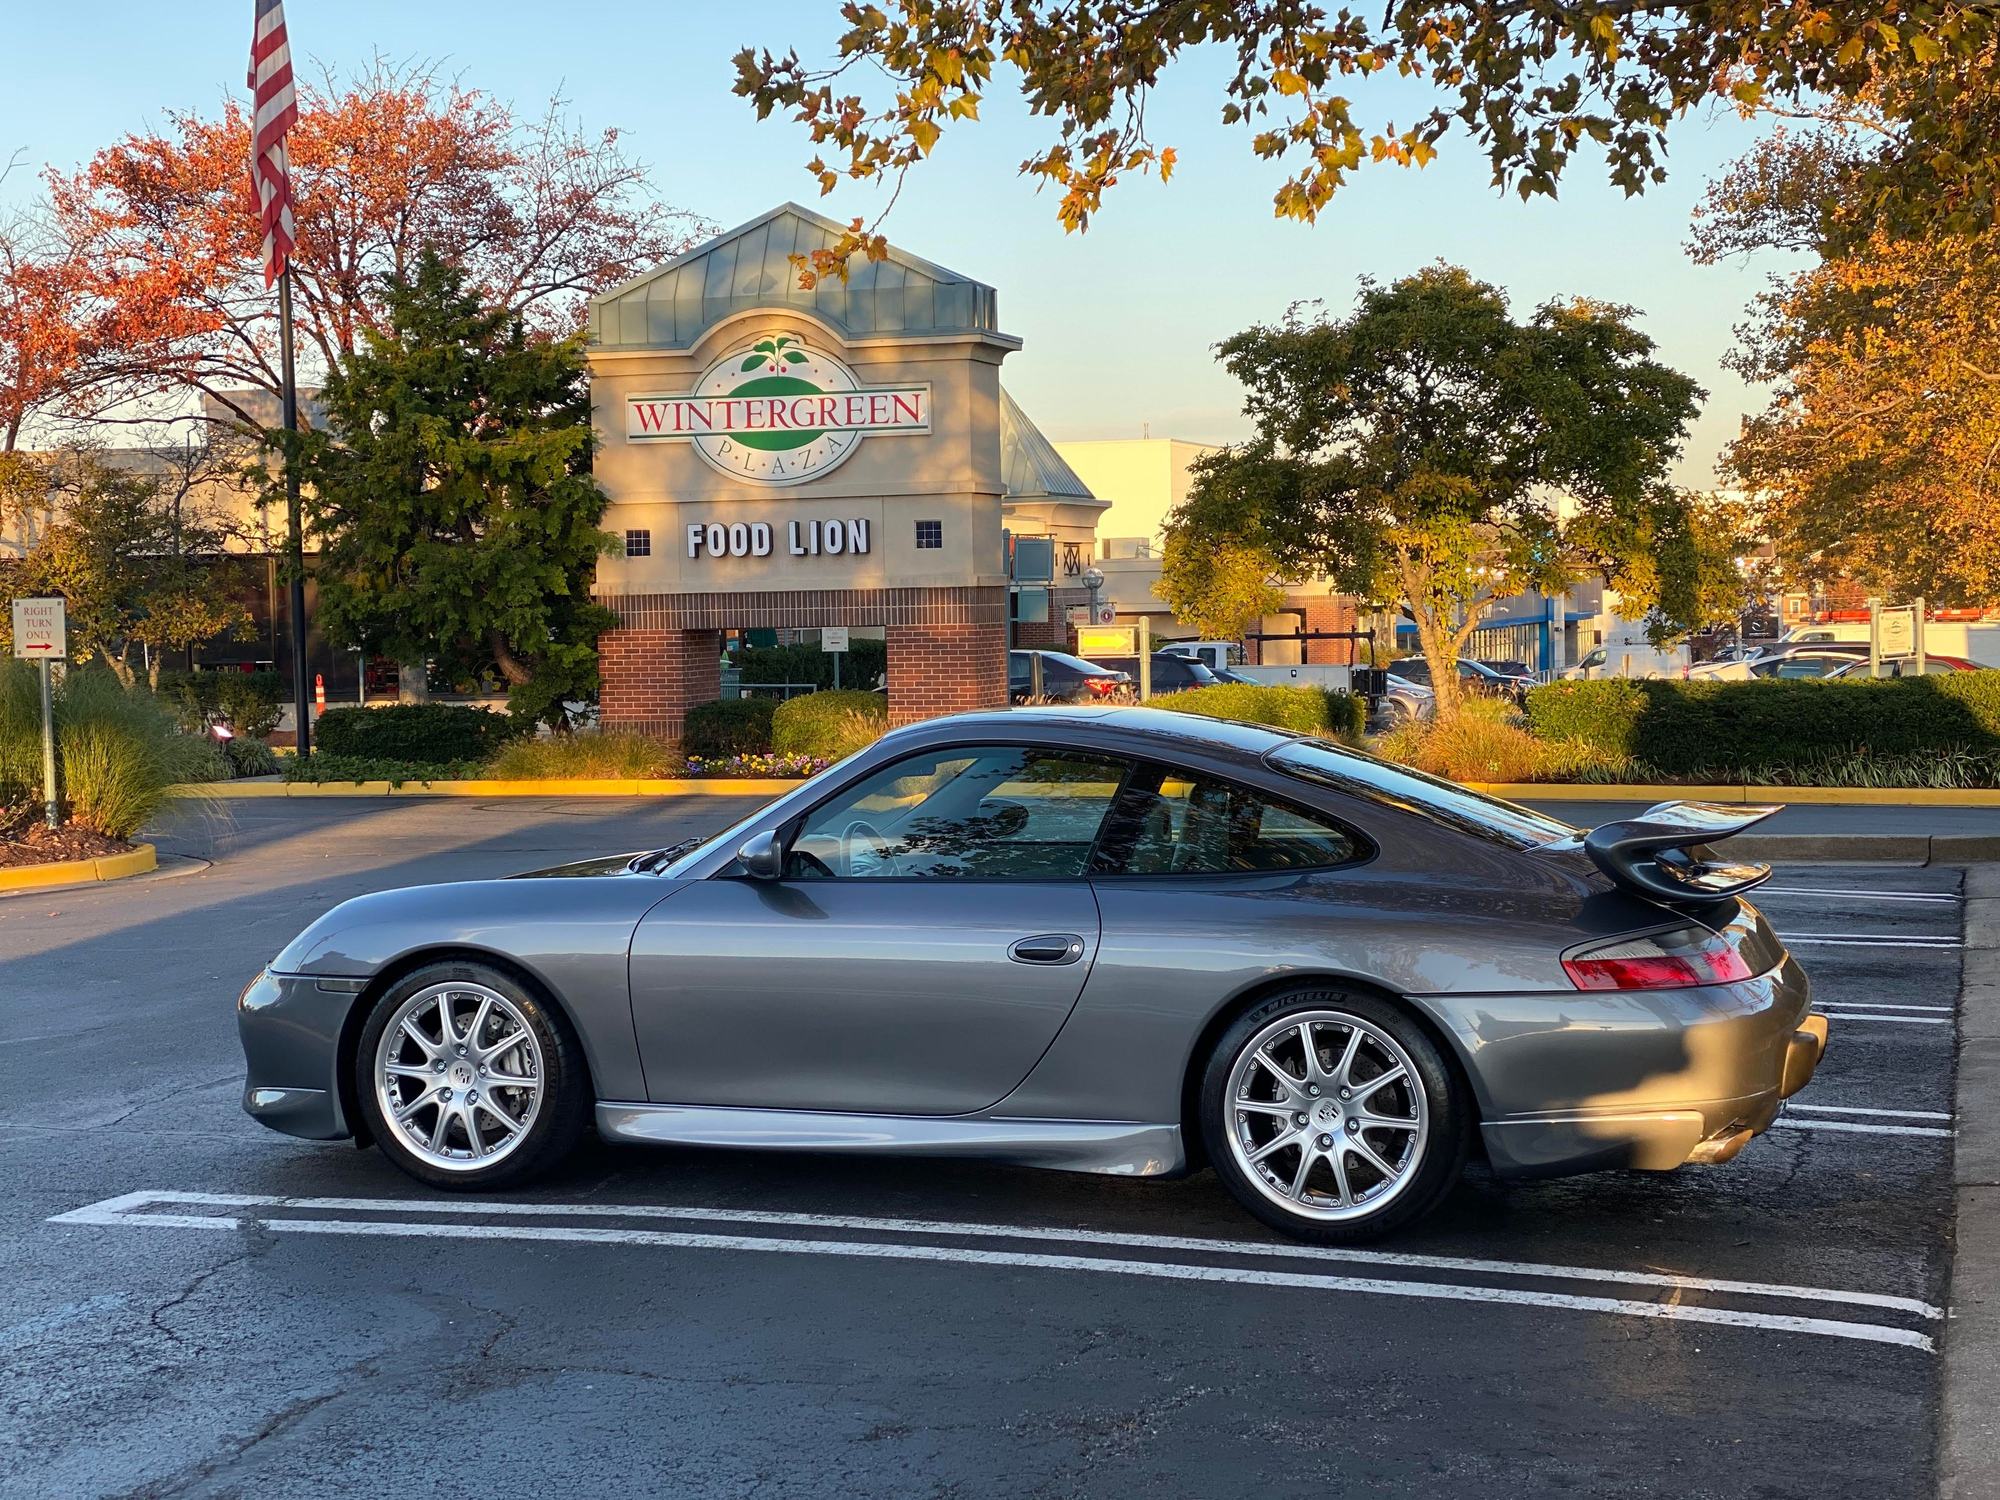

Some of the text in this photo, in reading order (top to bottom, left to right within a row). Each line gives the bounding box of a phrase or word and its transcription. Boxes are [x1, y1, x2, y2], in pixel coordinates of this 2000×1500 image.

[633, 394, 921, 432] WINTERGREEN
[687, 518, 870, 558] FOOD LION
[23, 606, 54, 616] RIGHT
[26, 618, 52, 628] TURN
[26, 630, 52, 640] ONLY
[1268, 991, 1343, 1012] MICHELIN
